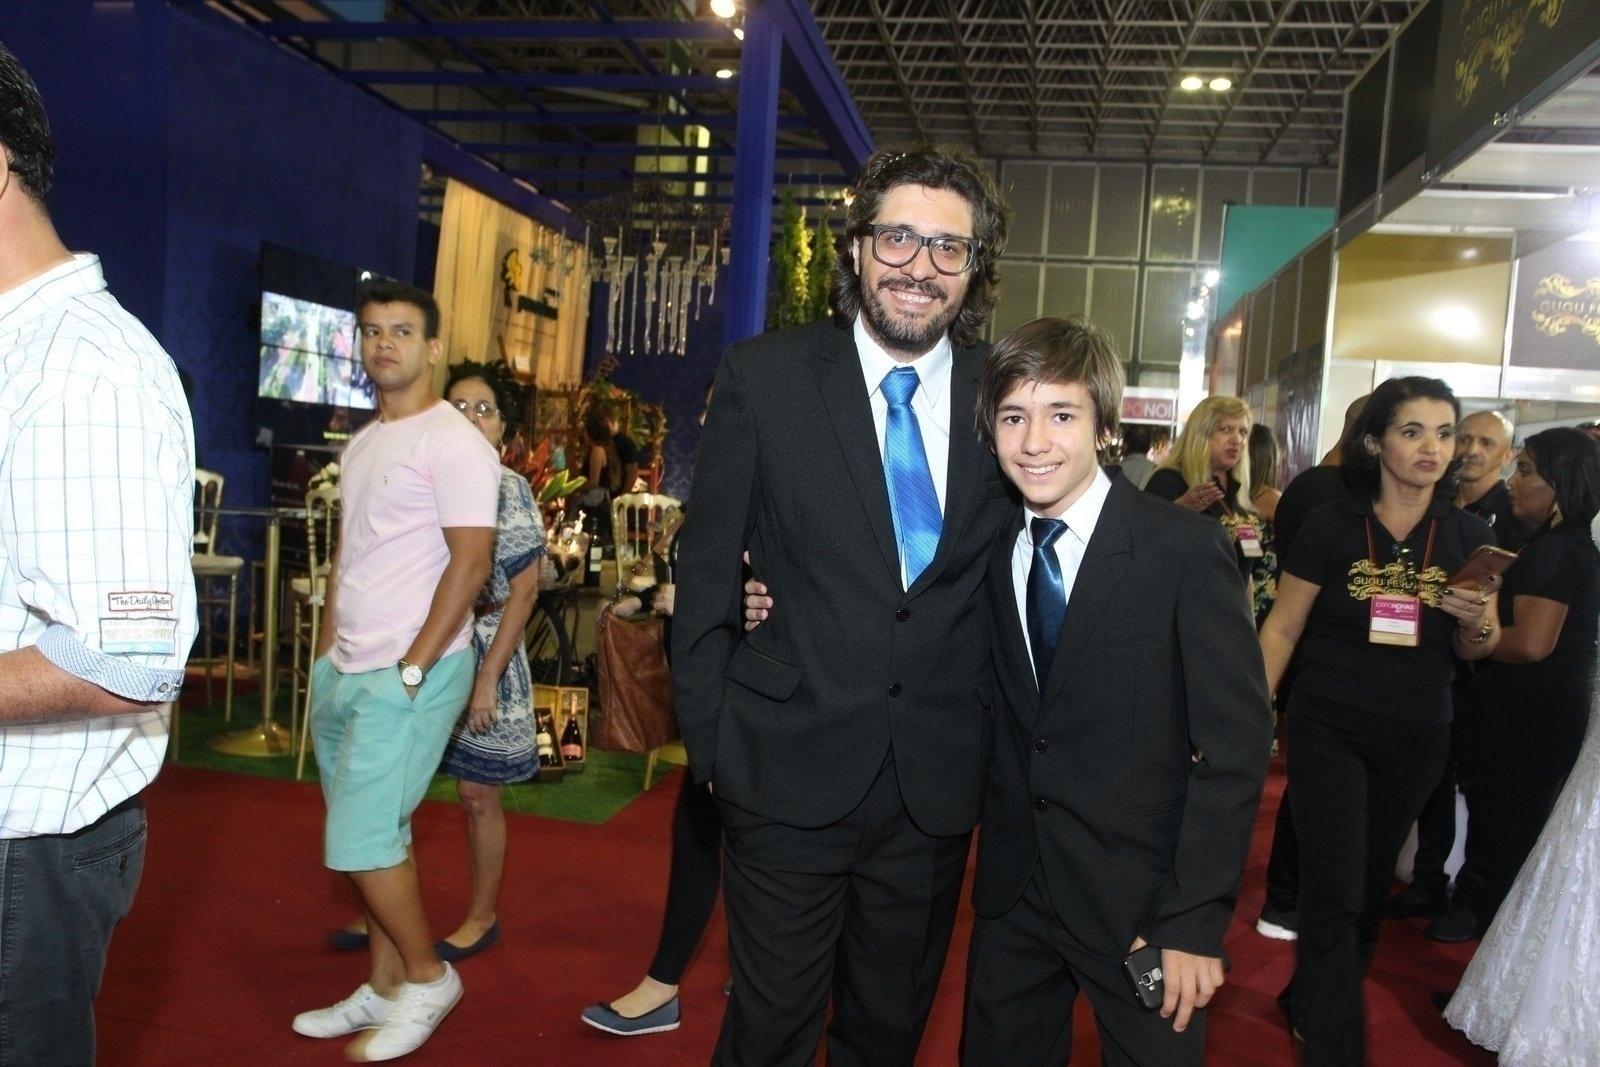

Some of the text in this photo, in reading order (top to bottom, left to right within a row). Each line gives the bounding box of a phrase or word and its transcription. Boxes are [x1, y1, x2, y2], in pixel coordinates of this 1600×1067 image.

[1540, 300, 1585, 314] GUGU
[1353, 576, 1384, 586] GUGU
[111, 596, 128, 606] The
[128, 595, 152, 608] Daily
